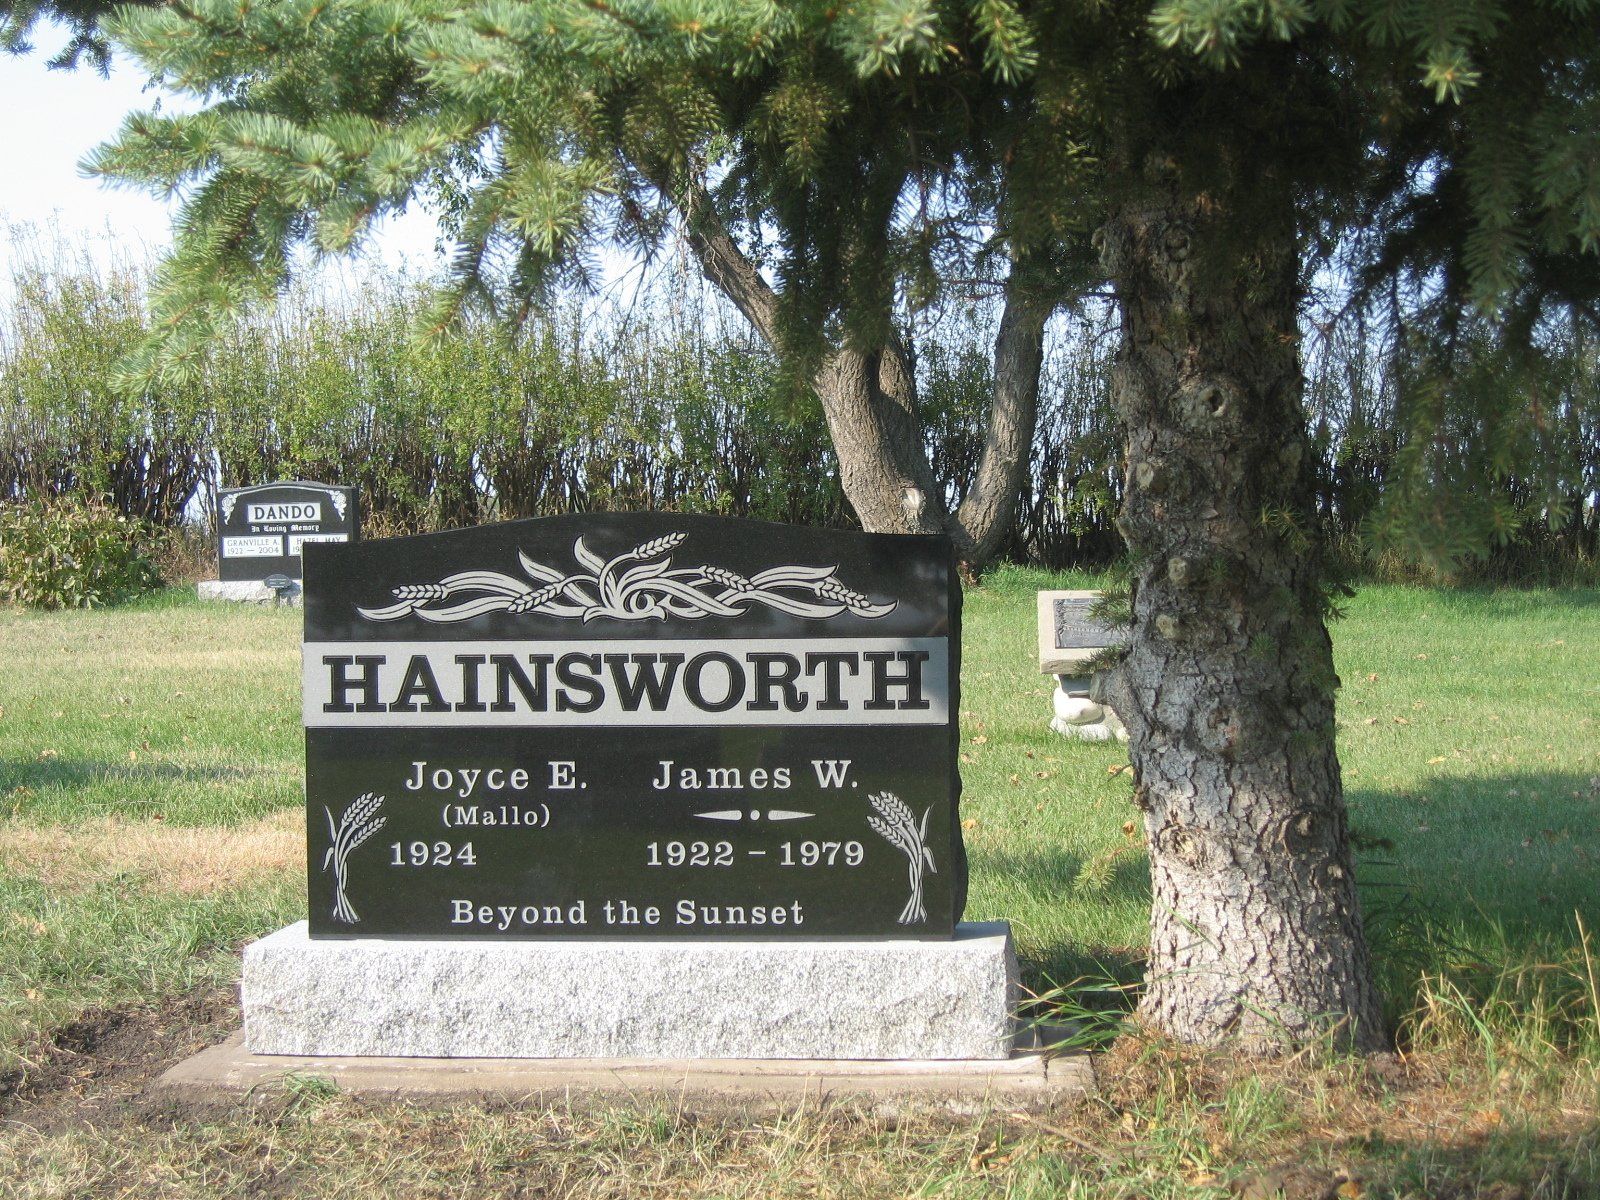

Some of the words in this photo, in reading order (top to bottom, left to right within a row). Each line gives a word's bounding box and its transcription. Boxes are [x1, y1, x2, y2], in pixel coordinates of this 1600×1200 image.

[254, 505, 315, 520] DANDO
[263, 525, 287, 533] Loving
[290, 524, 320, 532] Memory
[322, 651, 931, 714] HAINSWORTH
[405, 761, 530, 799] Joyce
[547, 760, 588, 791] E.
[651, 760, 793, 791] James
[810, 759, 859, 790] W.
[442, 803, 551, 828] (Mallo)
[390, 840, 478, 867] 1924
[646, 840, 735, 867] 1922
[780, 840, 865, 867] 1979
[450, 899, 588, 932] Beyond
[602, 900, 662, 926] the
[675, 899, 804, 926] Sunset
